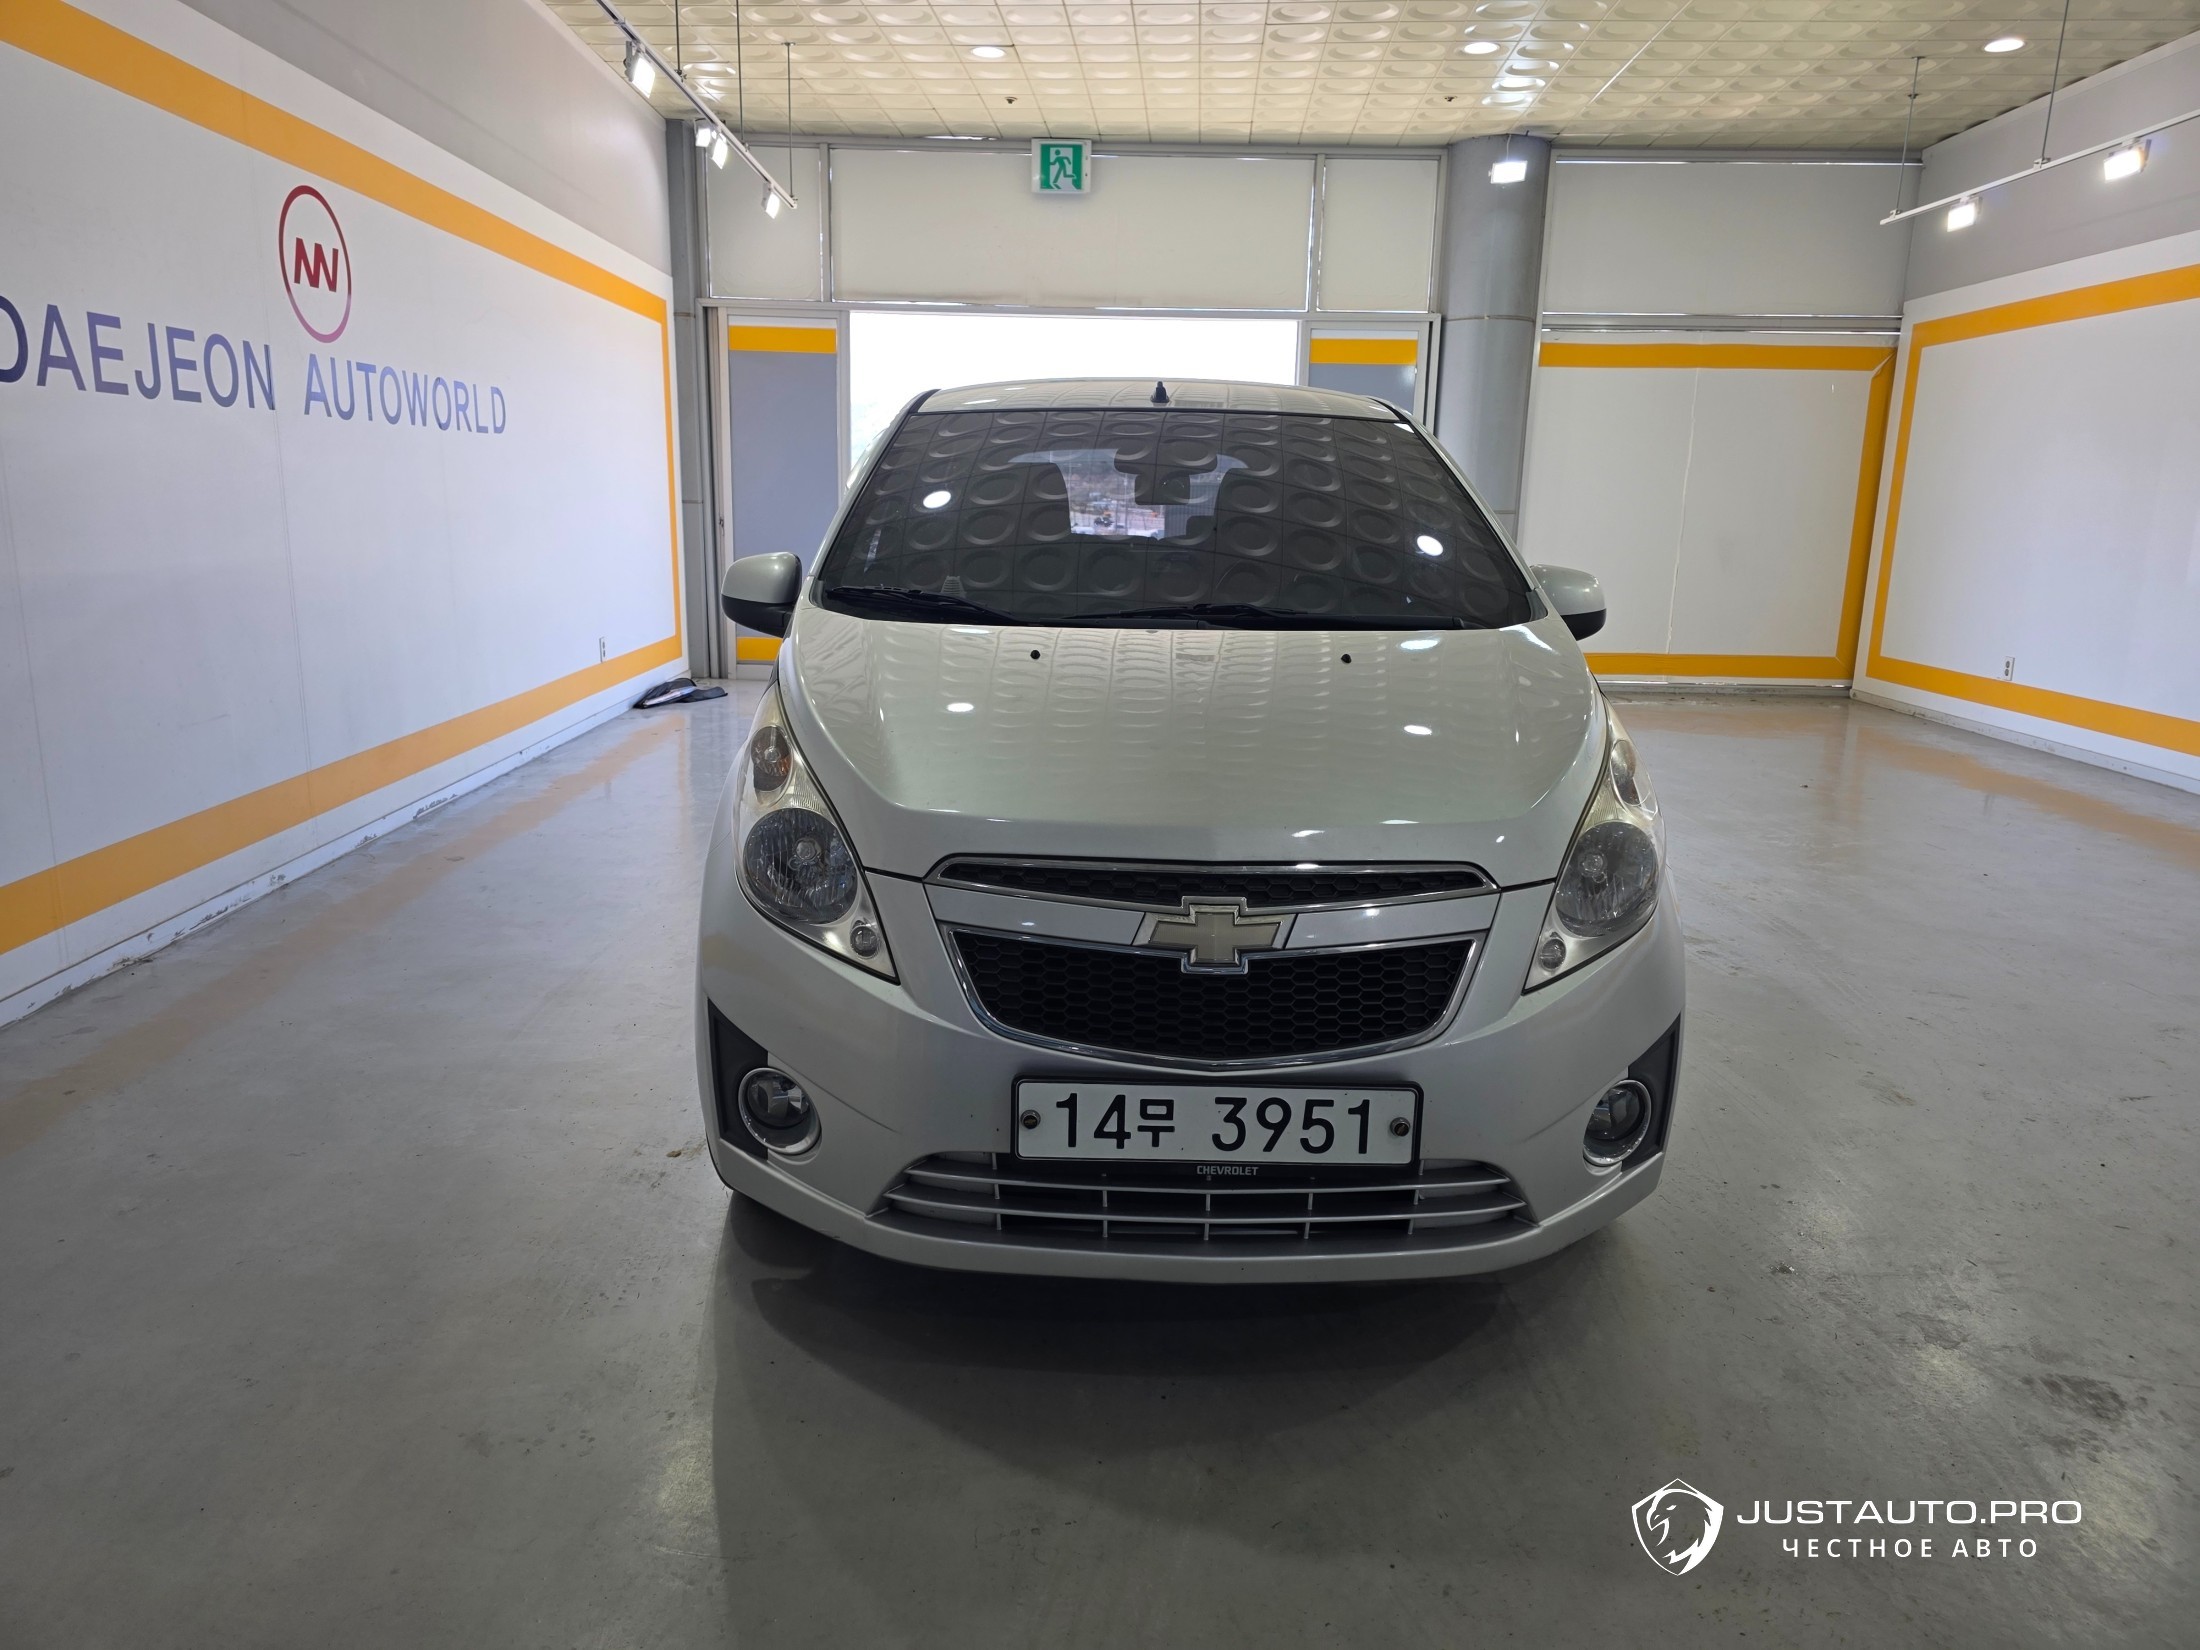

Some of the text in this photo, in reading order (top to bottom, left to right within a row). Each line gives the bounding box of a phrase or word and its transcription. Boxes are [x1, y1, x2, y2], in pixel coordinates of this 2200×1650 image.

[304, 353, 506, 435] AUTOWORLD
[1056, 1092, 1370, 1154] 14무 3951
[1196, 1164, 1259, 1176] CHEVROLET
